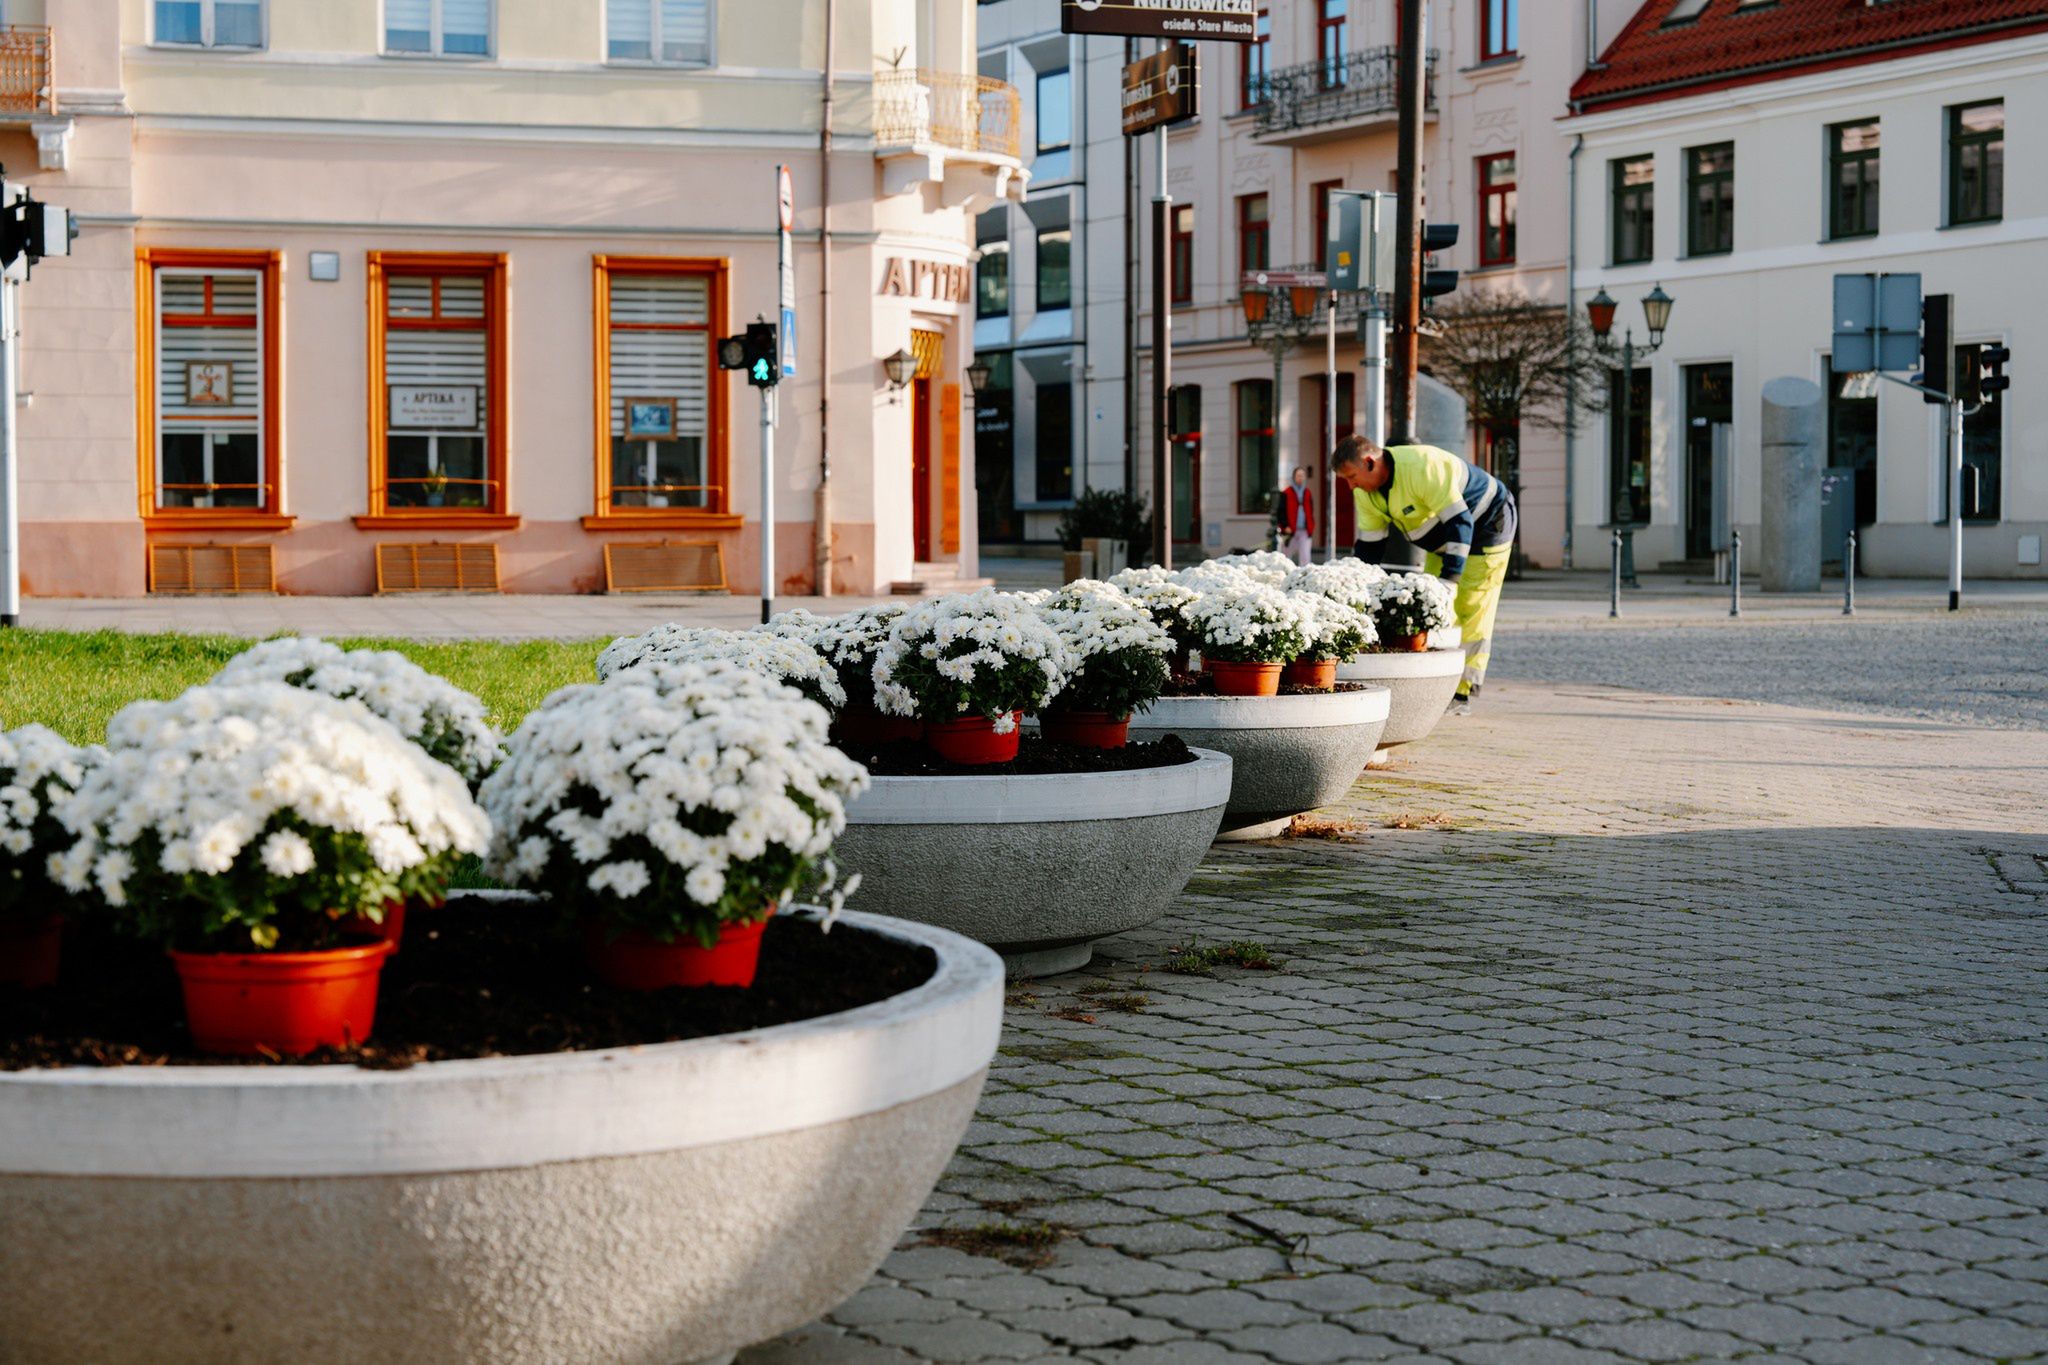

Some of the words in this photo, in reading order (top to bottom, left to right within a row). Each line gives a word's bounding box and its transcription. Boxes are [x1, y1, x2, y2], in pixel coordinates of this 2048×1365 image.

[1162, 18, 1196, 31] osiedle
[1197, 18, 1221, 32] Stare
[1222, 20, 1253, 34] Miasto
[413, 393, 455, 404] APTEKA
